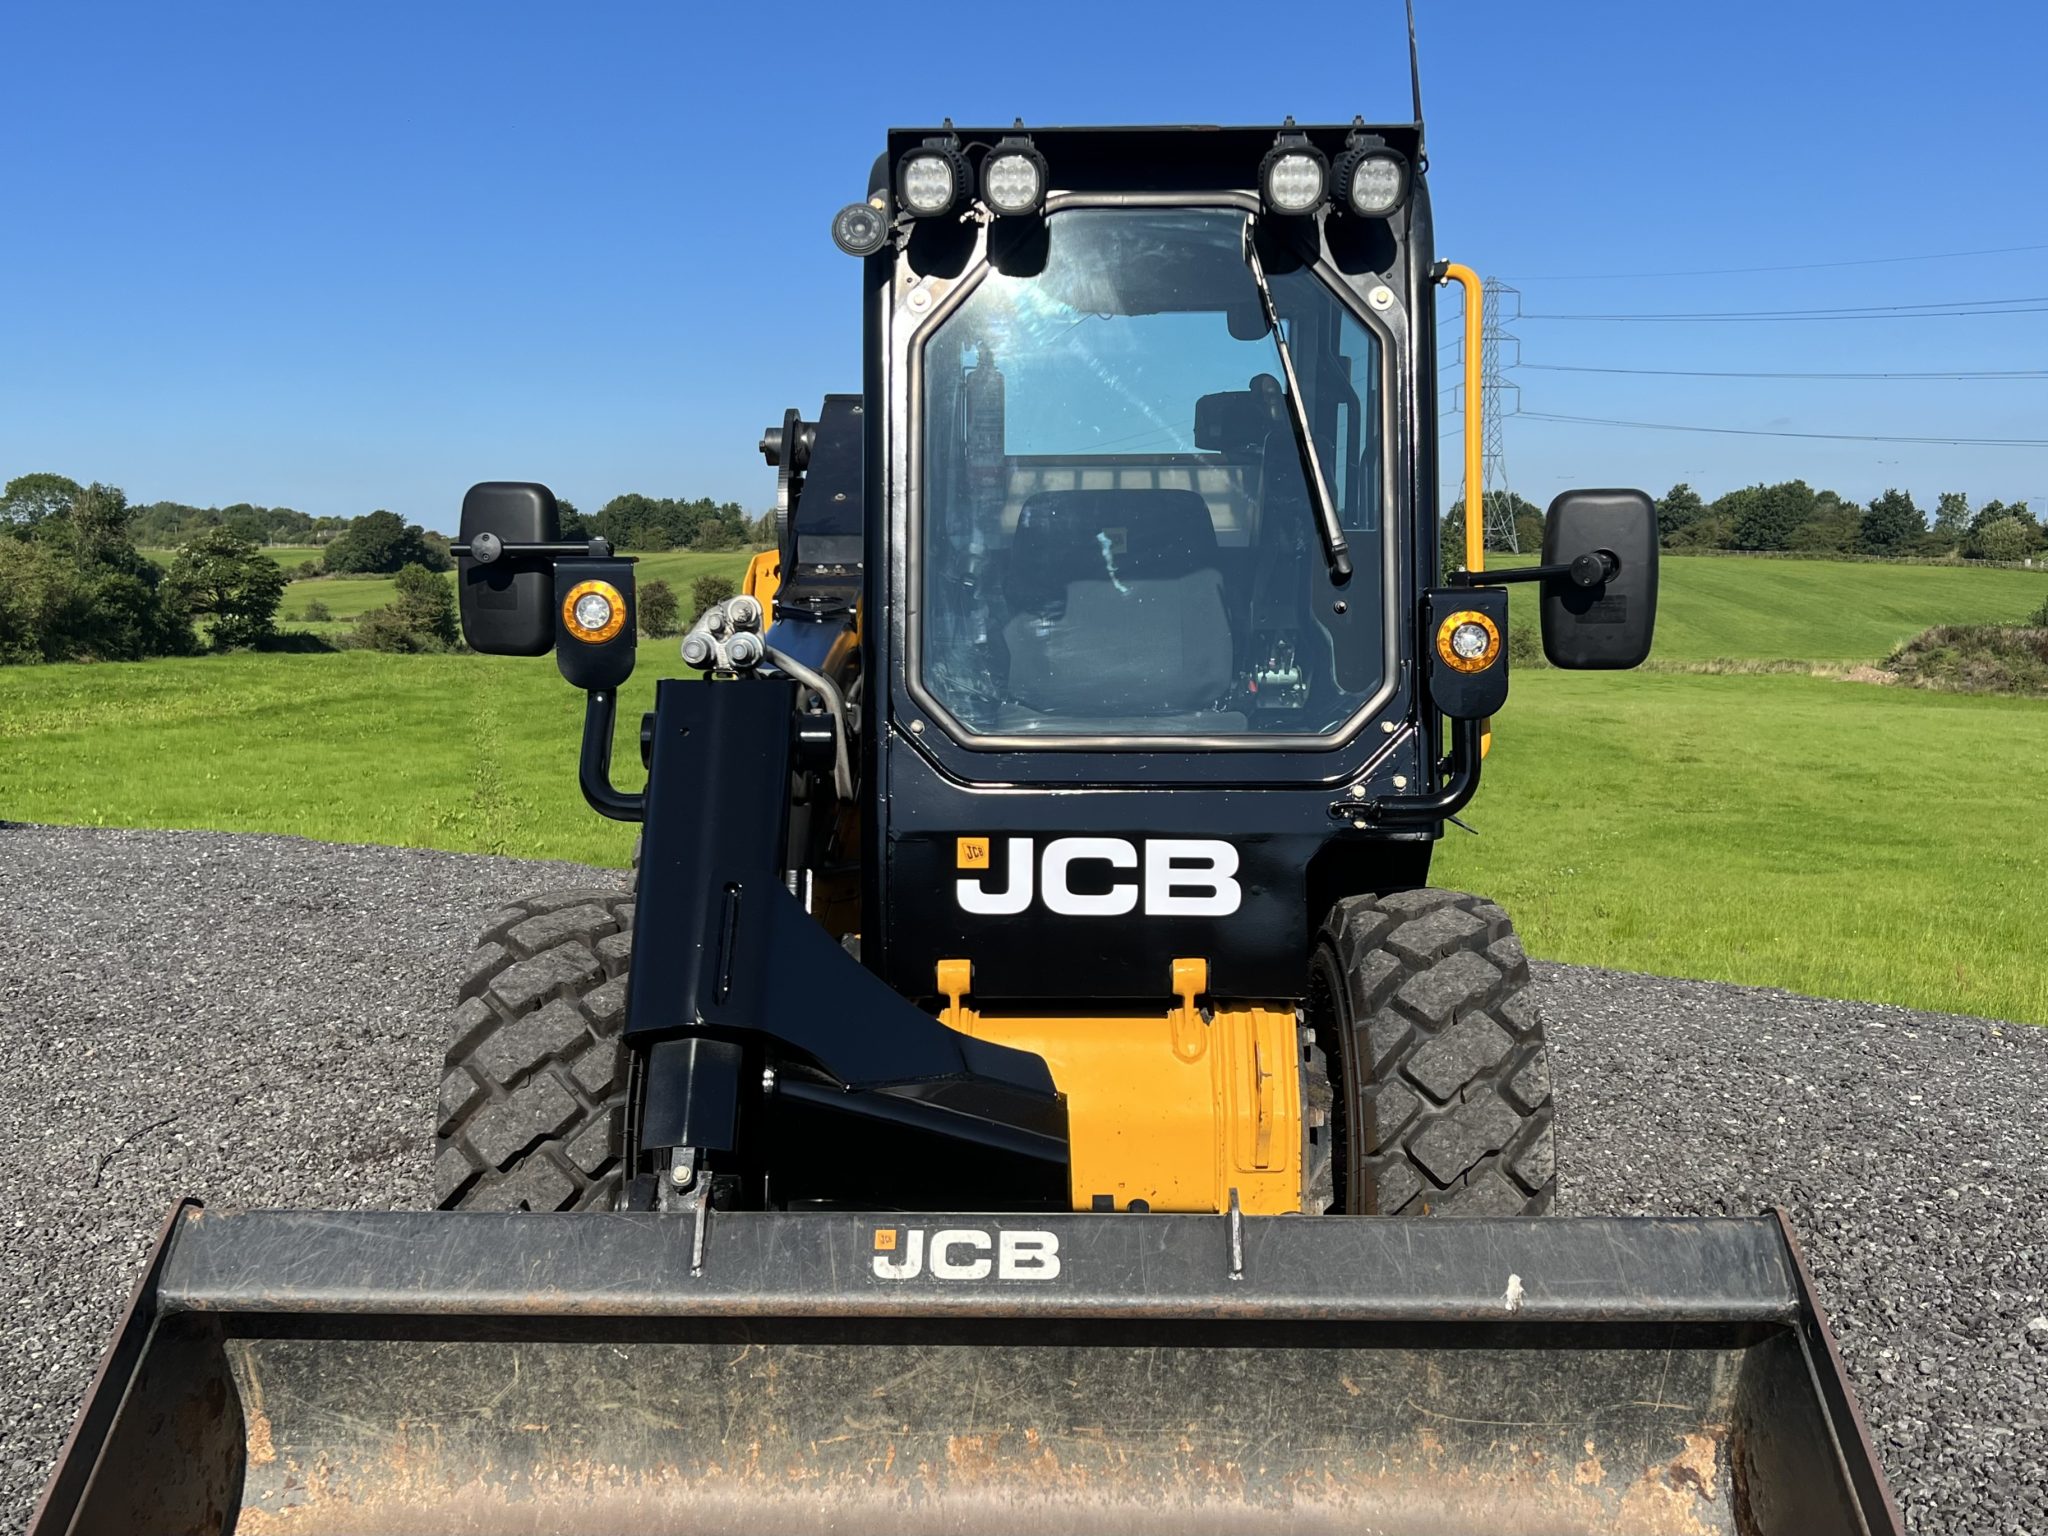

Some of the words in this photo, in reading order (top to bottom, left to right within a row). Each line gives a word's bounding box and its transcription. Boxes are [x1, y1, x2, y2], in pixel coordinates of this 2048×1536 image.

[956, 837, 1242, 916] JCB
[966, 845, 984, 860] JCB
[872, 1229, 1061, 1280] JCB
